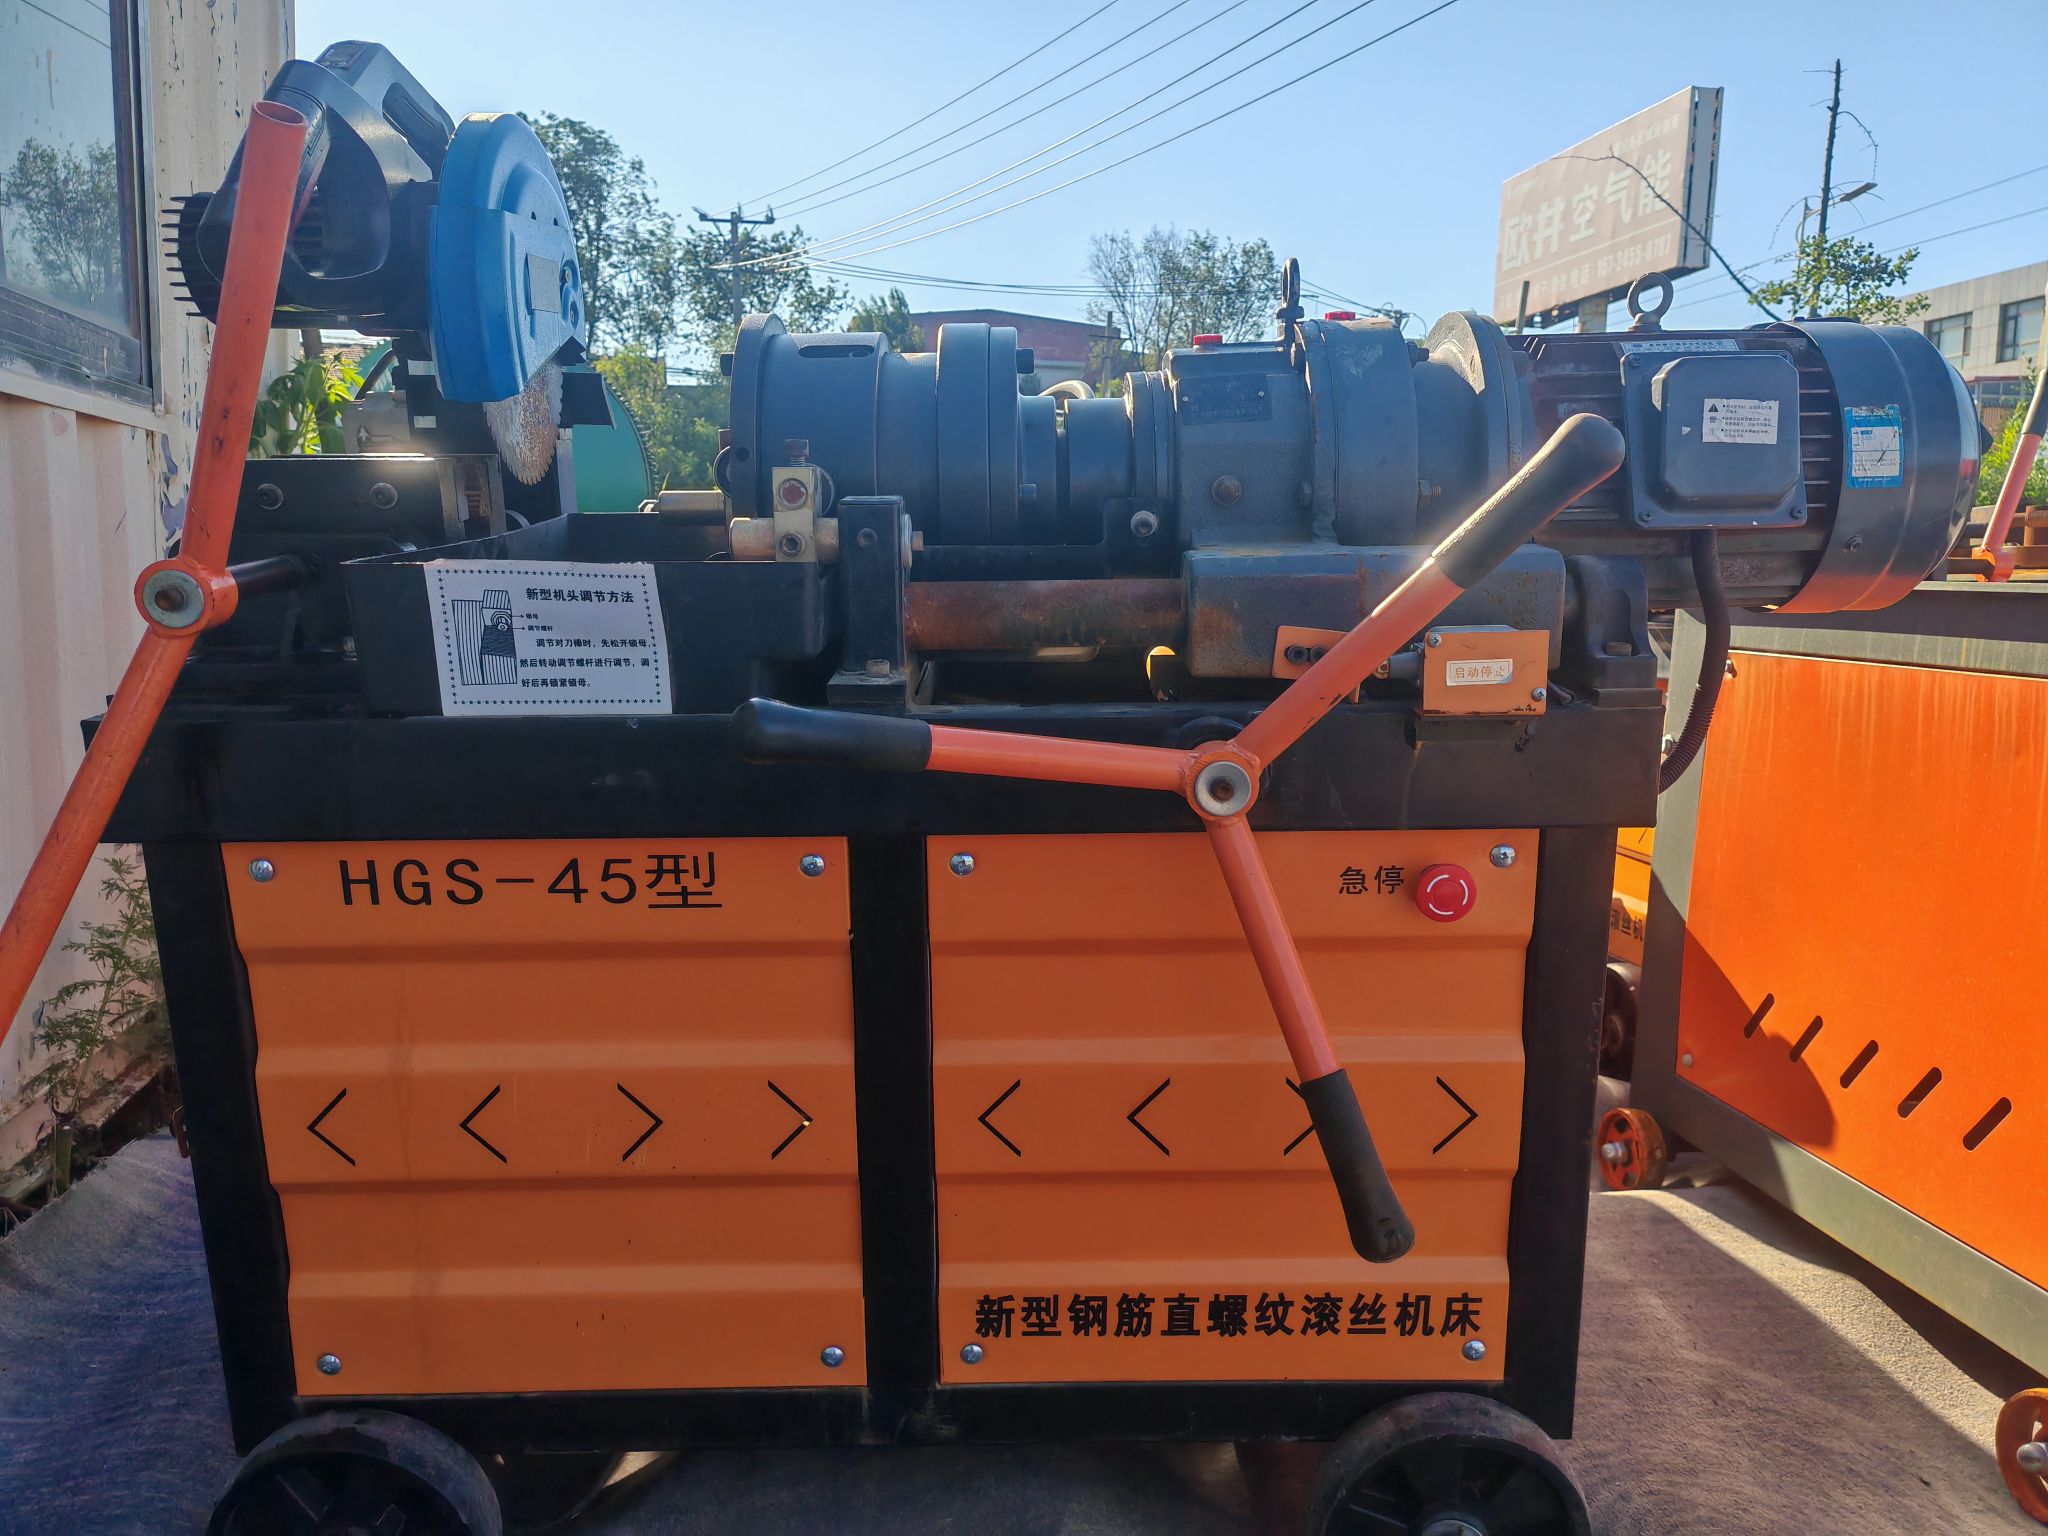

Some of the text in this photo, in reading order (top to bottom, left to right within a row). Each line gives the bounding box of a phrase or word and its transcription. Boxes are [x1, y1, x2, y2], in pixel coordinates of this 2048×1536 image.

[525, 587, 635, 603] 新型机头调节方法
[519, 657, 650, 668] 然后转动调节螺杆进行调节，调
[1454, 665, 1506, 679] 启动停止
[521, 677, 592, 688] 好后再锁紧锁母。
[338, 851, 723, 909] HGS-45型
[1338, 865, 1405, 895] 急停
[974, 1291, 1484, 1338] 新型钢筋直螺纹滚丝机床
